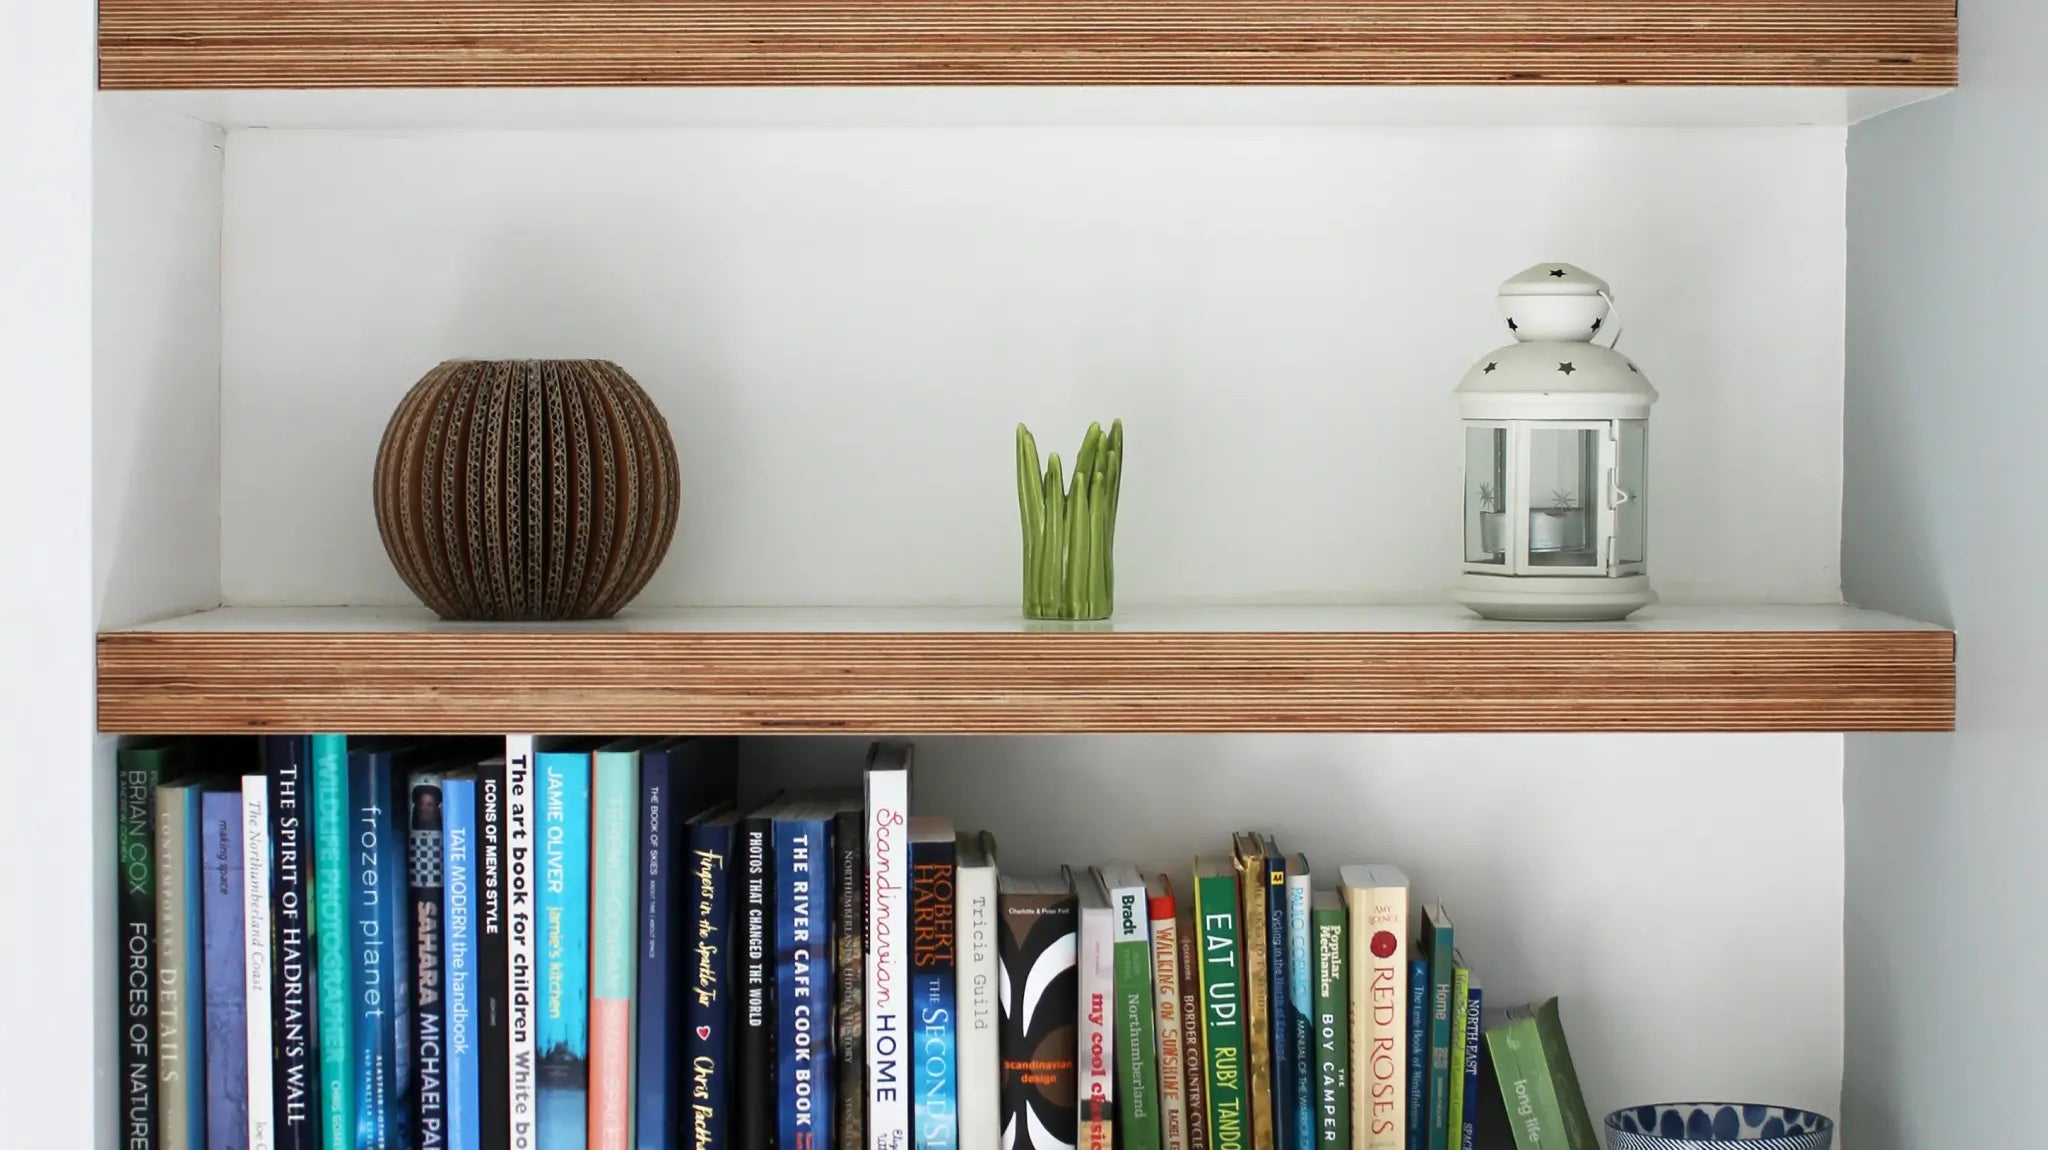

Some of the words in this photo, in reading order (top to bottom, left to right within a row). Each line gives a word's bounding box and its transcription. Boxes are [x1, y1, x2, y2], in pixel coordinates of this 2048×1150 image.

[280, 765, 297, 808] THE
[511, 754, 528, 796] The
[546, 765, 563, 821] JAMIE
[650, 786, 659, 804] THE
[129, 770, 147, 836] BRIAN
[248, 800, 262, 826] The
[318, 755, 340, 863] WILDLIFE
[485, 779, 498, 822] ICONS
[511, 803, 526, 839] art
[650, 805, 659, 833] BOOK
[217, 819, 230, 860] making
[280, 816, 299, 885] SPIRIT
[360, 805, 382, 907] frozen
[450, 827, 466, 862] TATE
[485, 825, 498, 843] OF
[650, 834, 659, 848] OF
[749, 831, 763, 874] PHOTOS
[793, 834, 809, 873] THE
[129, 843, 149, 896] COX
[217, 863, 231, 896] space
[485, 846, 498, 887] MEN'S
[512, 846, 530, 905] book
[547, 826, 564, 894] OLIVER
[649, 849, 659, 876] SKIES
[694, 849, 723, 898] Fingers
[161, 813, 173, 958] CONTEMPORARY
[249, 829, 263, 948] Northumberland
[281, 891, 299, 920] OF
[451, 866, 467, 938] MODERN
[749, 878, 763, 904] THAT
[876, 808, 904, 1008] Scandinavian
[1290, 887, 1305, 929] PAULO
[486, 890, 499, 934] STYLE
[513, 912, 530, 946] for
[699, 901, 713, 917] in
[699, 918, 718, 939] the
[793, 881, 809, 941] RIVER
[913, 864, 936, 968] HARRIS
[933, 864, 954, 967] ROBERT
[973, 897, 986, 963] Tricia
[1121, 894, 1137, 936] Bradt
[1272, 909, 1284, 946] Cycling
[418, 900, 438, 1006] SAHARA
[452, 941, 467, 968] the
[547, 905, 565, 960] jamie's
[749, 908, 763, 959] CHANGED
[1206, 914, 1234, 968] EAT
[1275, 947, 1283, 957] in
[1328, 924, 1342, 979] Popular
[129, 922, 148, 1016] FORCES
[251, 952, 264, 993] Coast
[320, 868, 345, 1063] PHOTOGRAPHER
[359, 919, 385, 1019] planet
[695, 942, 718, 988] Sparkle
[749, 963, 763, 984] THE
[794, 948, 810, 997] CAFE
[1156, 927, 1176, 995] WALKING
[1275, 959, 1284, 975] the
[1320, 924, 1332, 998] Mechanics
[283, 928, 304, 1057] HADRIAN'S
[513, 952, 530, 1041] children
[549, 962, 564, 1019] kitchen
[693, 987, 717, 1008] Jar
[749, 988, 763, 1027] WORLD
[843, 967, 854, 1012] HIDDEN
[929, 977, 941, 1004] THE
[973, 974, 988, 1030] Guild
[1089, 992, 1105, 1027] my
[1160, 1001, 1175, 1021] ON
[1209, 981, 1237, 1028] UP!
[1370, 966, 1395, 1026] RED
[1413, 986, 1425, 1005] The
[1435, 983, 1450, 1020] Home
[160, 968, 180, 1082] DETAILS
[452, 971, 468, 1055] handbook
[795, 1004, 811, 1061] COOK
[1183, 994, 1198, 1045] BORDER
[1322, 1013, 1334, 1052] BOY
[130, 1024, 148, 1057] OF
[843, 1015, 854, 1063] HISTORY
[876, 1013, 897, 1103] HOME
[1090, 1031, 1107, 1076] cool
[1127, 993, 1147, 1118] Northumberland
[1297, 1019, 1306, 1059] MANUAL
[1412, 1029, 1424, 1055] Book
[1465, 999, 1480, 1076] NORTH-EAST
[419, 1012, 440, 1114] MICHAEL
[515, 1049, 531, 1114] White
[693, 1055, 715, 1097] Chris
[922, 1007, 949, 1117] SECOND
[1003, 1060, 1072, 1070] scandinavian
[1020, 1073, 1057, 1085] design
[1160, 1028, 1179, 1101] SUNSHINE
[1185, 1047, 1200, 1108] COUNTRY
[1214, 1046, 1239, 1090] RUBY
[1298, 1061, 1307, 1075] OF
[1412, 1056, 1422, 1070] of
[130, 1063, 148, 1150] NATURE
[286, 1063, 305, 1126] WALL
[795, 1068, 812, 1126] BOOK
[1298, 1077, 1307, 1094] THE
[1323, 1060, 1336, 1141] CAMPER
[1370, 1036, 1395, 1135] ROSES
[1168, 1108, 1180, 1139] RACHEL
[1188, 1111, 1203, 1150] CYCLE
[1513, 1079, 1533, 1116] long
[1524, 1115, 1541, 1143] life
